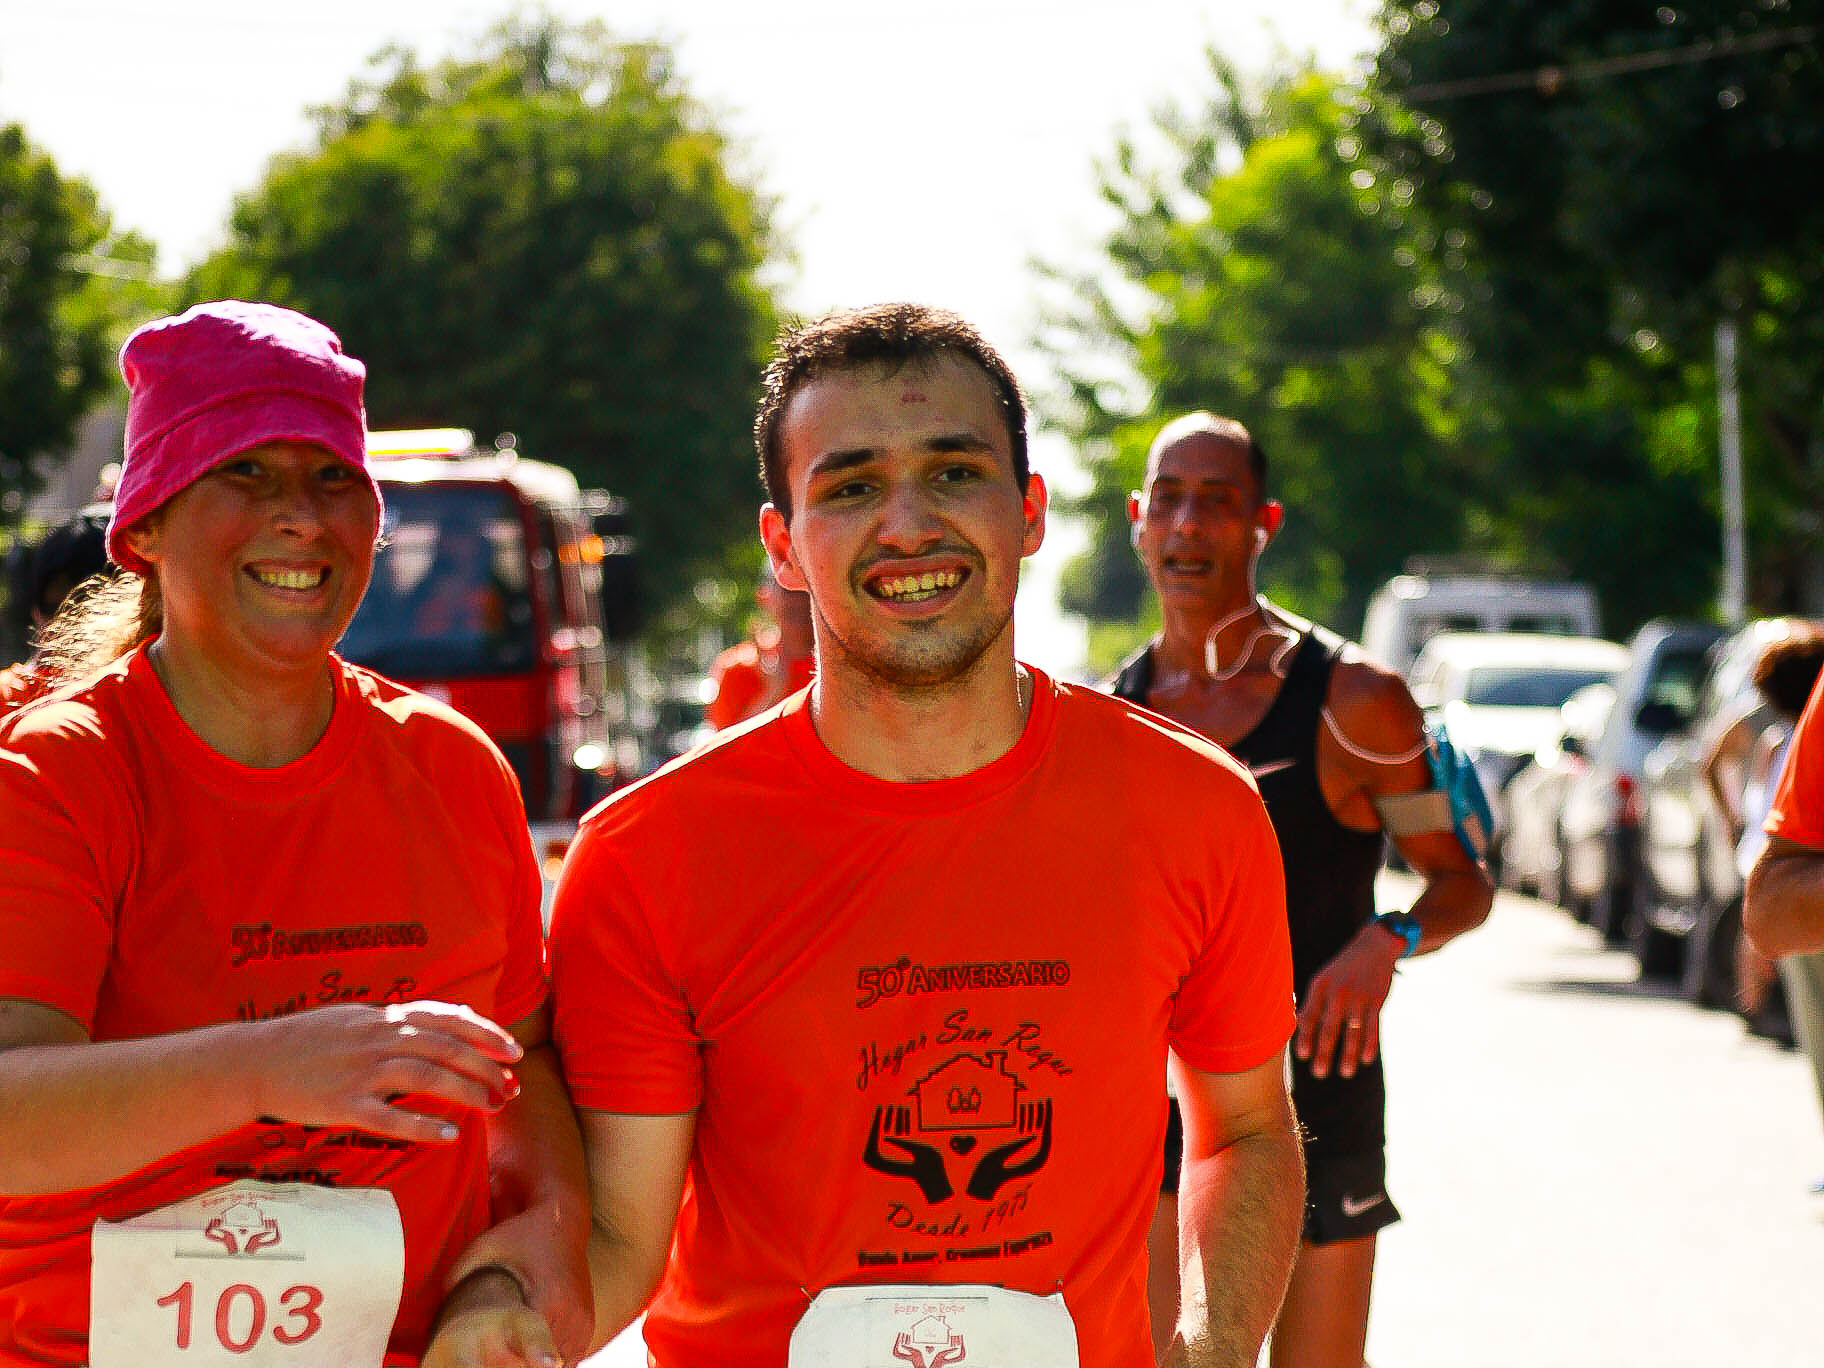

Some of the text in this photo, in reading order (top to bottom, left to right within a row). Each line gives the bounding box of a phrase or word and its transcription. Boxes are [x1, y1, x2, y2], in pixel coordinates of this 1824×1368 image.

[907, 961, 1070, 994] ANIVERSARIO
[857, 1008, 1073, 1090] Hogar San Roque
[887, 1203, 969, 1236] Desde
[156, 1281, 325, 1354] 103
